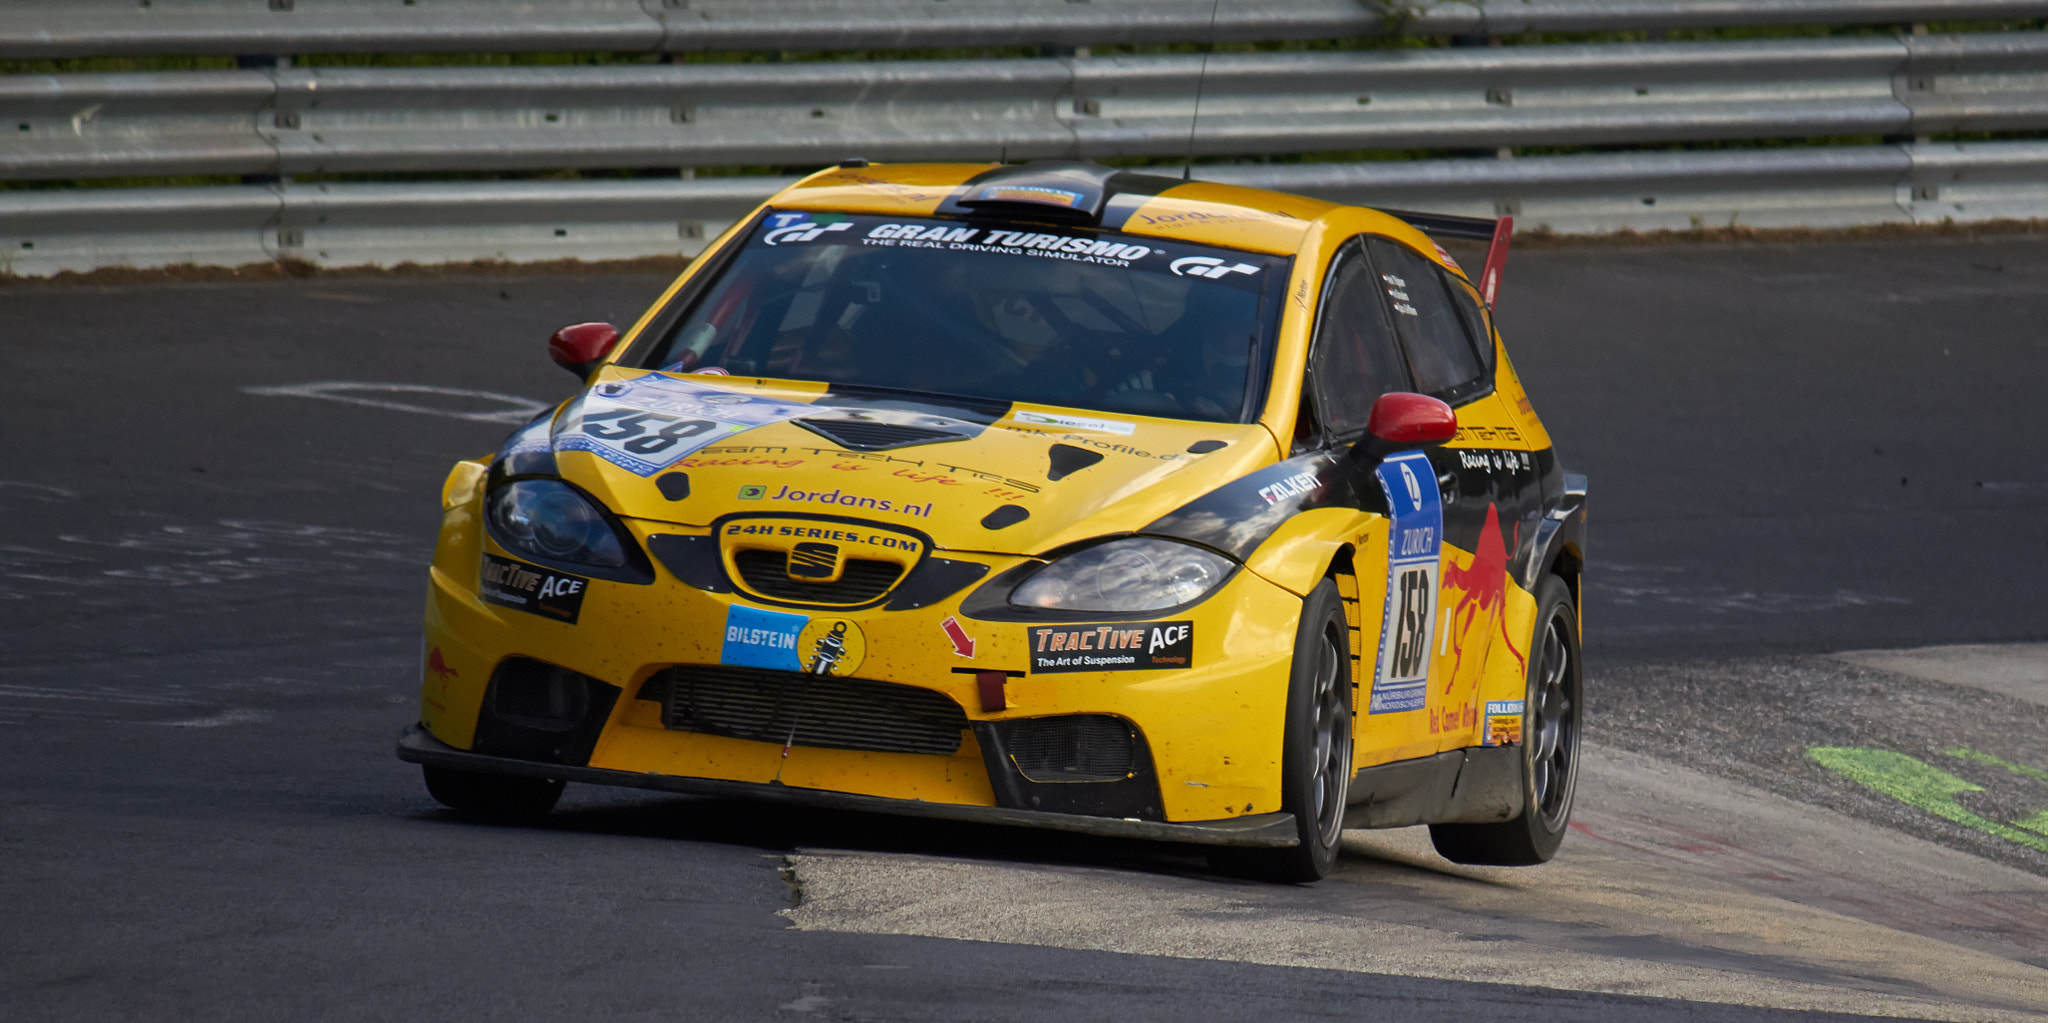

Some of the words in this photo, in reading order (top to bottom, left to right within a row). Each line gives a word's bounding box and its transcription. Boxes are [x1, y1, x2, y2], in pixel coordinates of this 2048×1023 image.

[861, 238, 896, 247] THE
[899, 239, 946, 250] REAL
[949, 242, 1023, 256] DRIVING
[1025, 247, 1130, 268] SIMULATOR
[867, 223, 981, 243] GRAN
[983, 229, 1152, 261] TURISMO
[557, 407, 717, 454] 158
[1458, 448, 1491, 475] Racing
[1491, 449, 1502, 471] is
[670, 455, 805, 469] Racing
[831, 460, 871, 472] is
[892, 468, 964, 487] life
[982, 488, 1025, 501] !!!
[1258, 471, 1323, 506] FALKEN
[771, 484, 934, 519] Jordans.nl
[726, 525, 775, 536] 24H
[778, 525, 918, 553] SERIES.COM
[1401, 526, 1434, 556] ZURICH
[537, 575, 584, 600] ACE
[726, 625, 797, 650] BILSTEIN
[1390, 568, 1430, 679] 158
[1148, 624, 1190, 654] ACE
[1037, 657, 1055, 667] The
[1056, 656, 1071, 667] Art
[1072, 655, 1082, 666] of
[1083, 654, 1136, 666] Suspension
